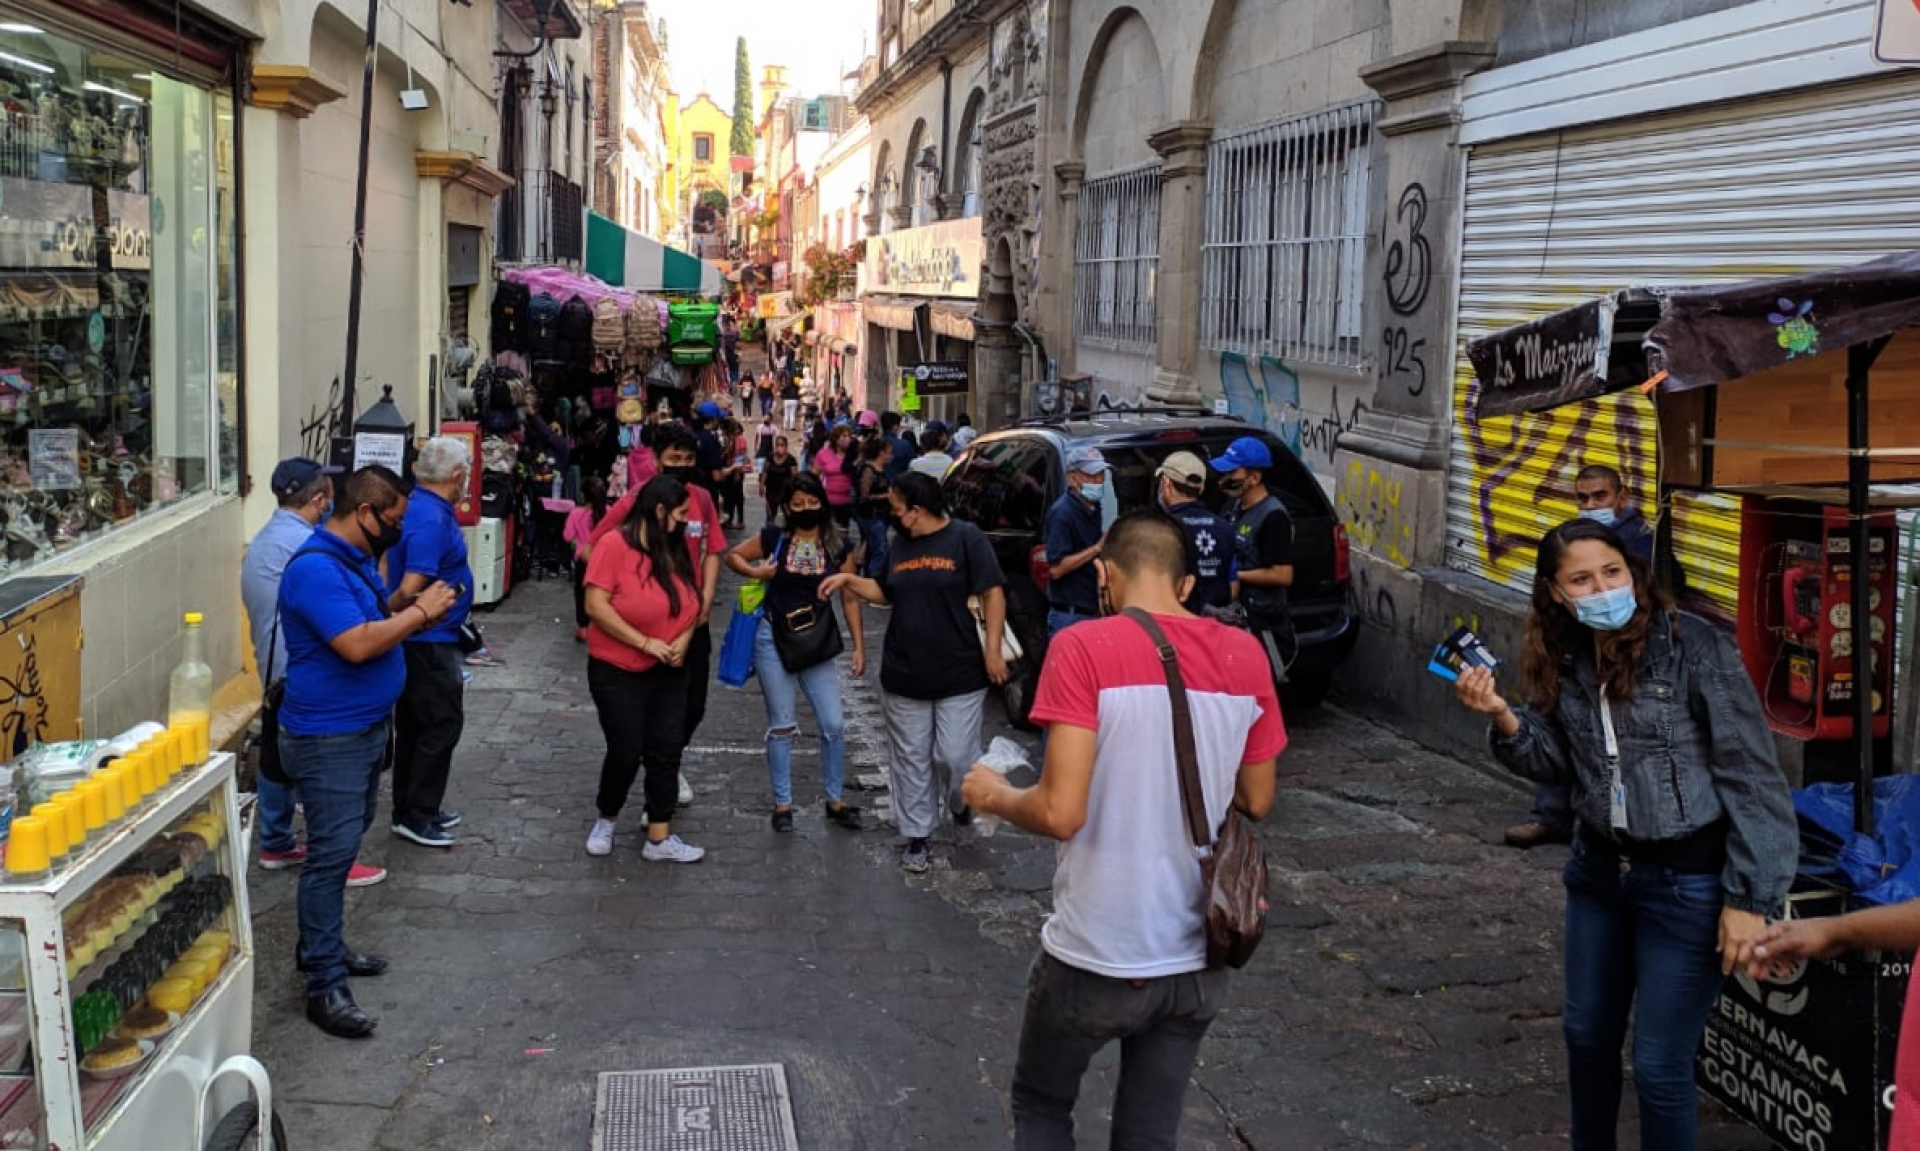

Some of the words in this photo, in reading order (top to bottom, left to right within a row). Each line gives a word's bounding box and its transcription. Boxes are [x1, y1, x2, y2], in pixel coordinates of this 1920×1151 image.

[1880, 962, 1911, 977] 201
[1704, 1025, 1832, 1134] ESTAMOS
[1713, 993, 1849, 1095] ERNAVACA
[1704, 1056, 1827, 1151] CONTIGO
